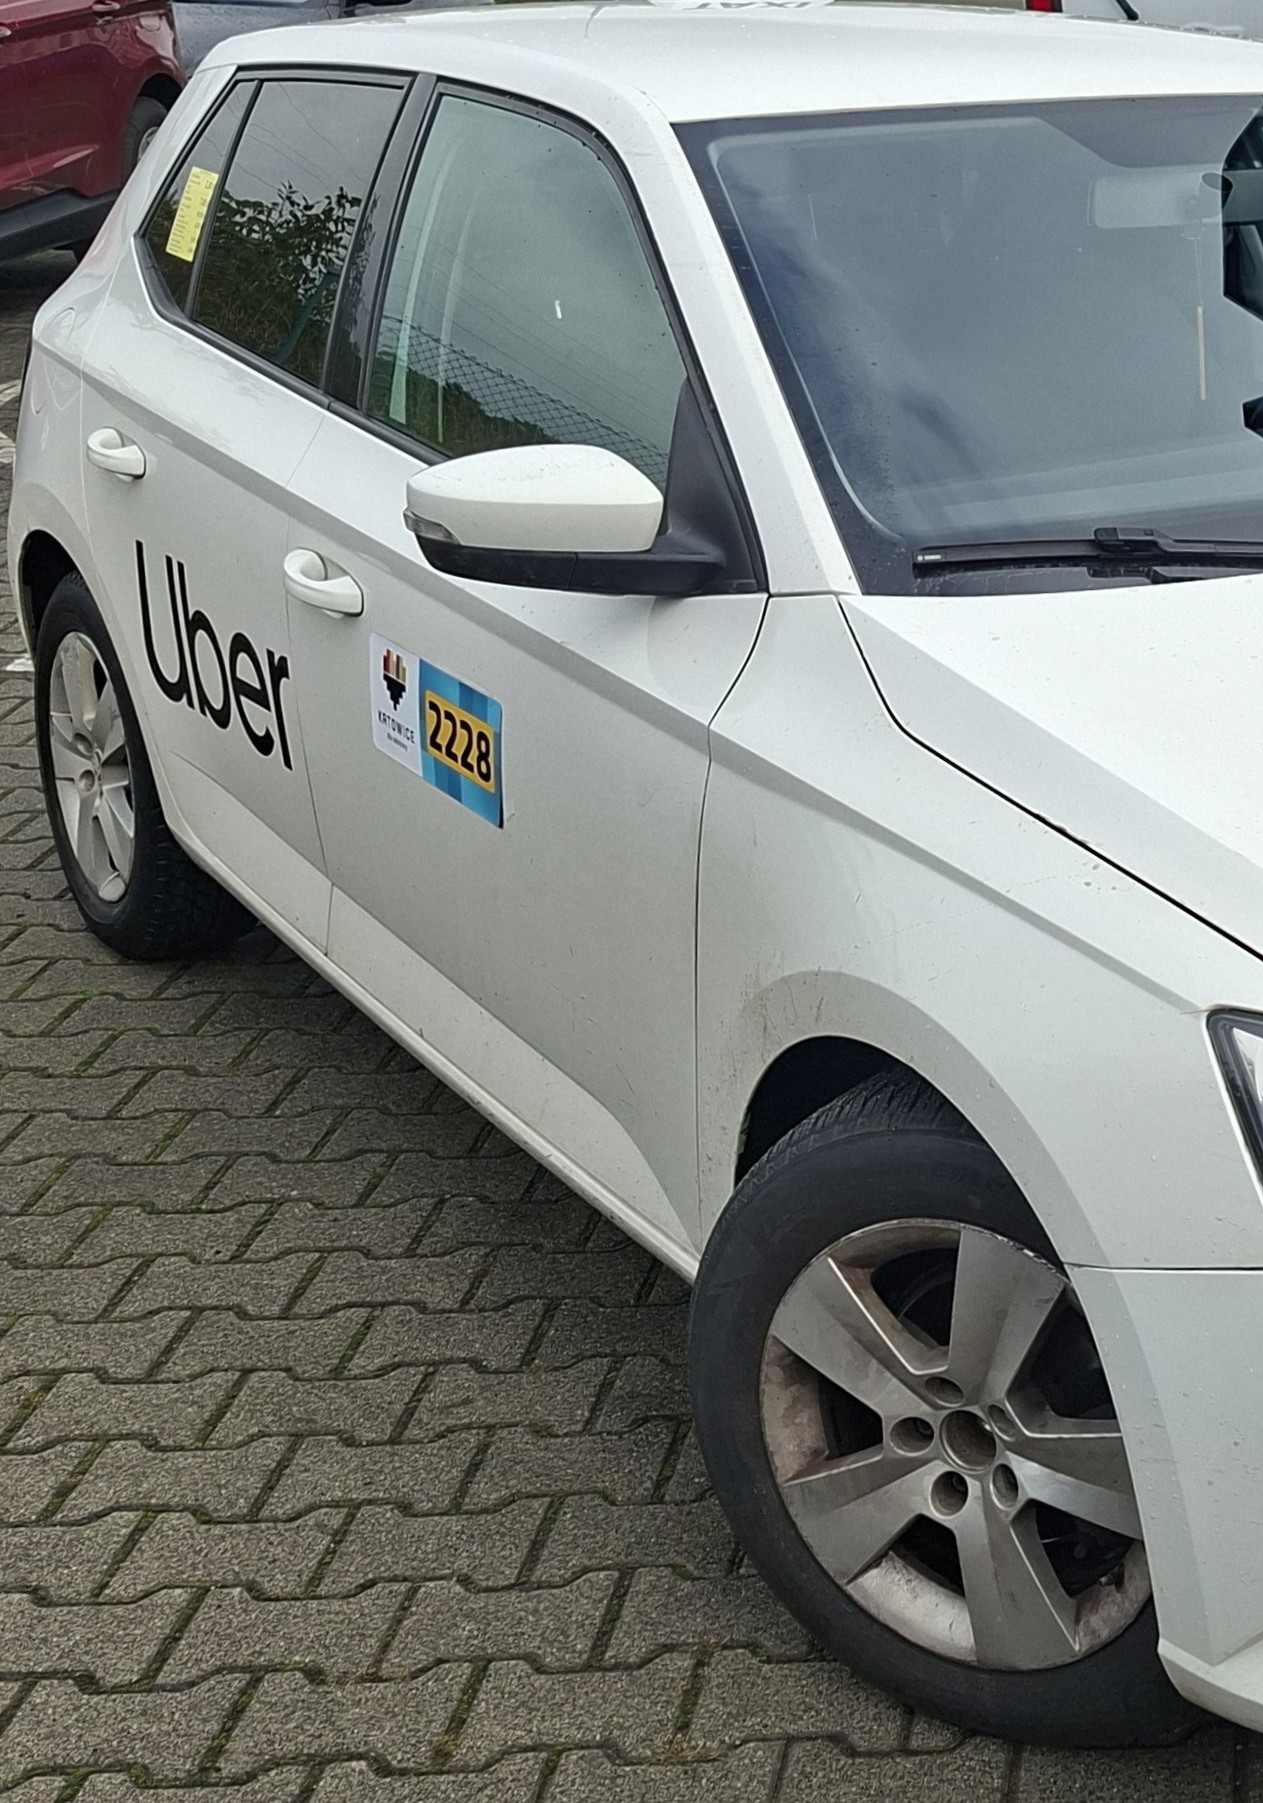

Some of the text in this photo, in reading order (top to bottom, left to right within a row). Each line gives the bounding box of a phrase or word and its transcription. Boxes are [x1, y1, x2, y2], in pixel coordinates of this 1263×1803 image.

[135, 539, 293, 772] Uber
[378, 709, 416, 744] KATOWICE
[428, 700, 492, 783] 2228
